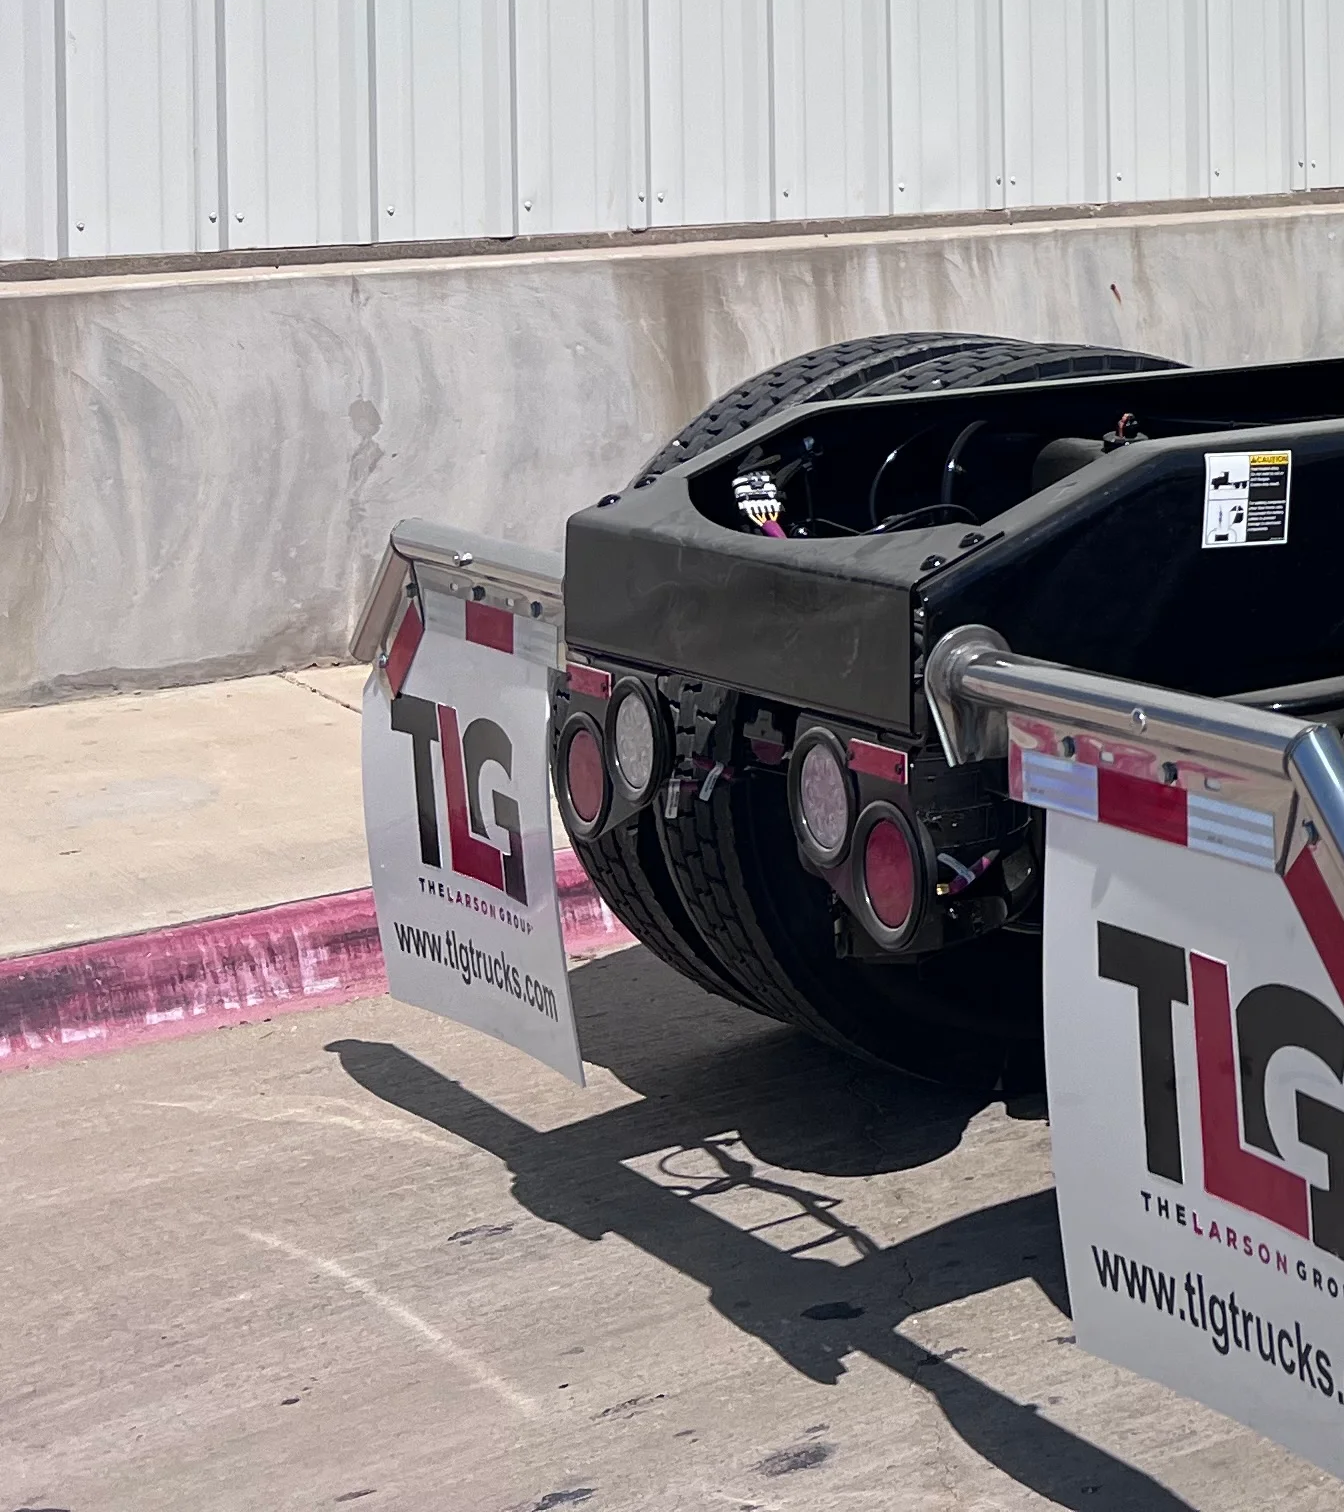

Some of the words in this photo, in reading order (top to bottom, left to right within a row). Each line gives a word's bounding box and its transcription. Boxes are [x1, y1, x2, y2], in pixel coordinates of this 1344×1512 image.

[391, 692, 529, 908] TLG
[418, 876, 445, 899] THE
[446, 890, 497, 922] LARSON
[499, 907, 532, 936] GROUP
[393, 921, 559, 1024] www.tlgtrucks.com
[1139, 1190, 1188, 1227] THE
[1192, 1210, 1288, 1275] LARSON
